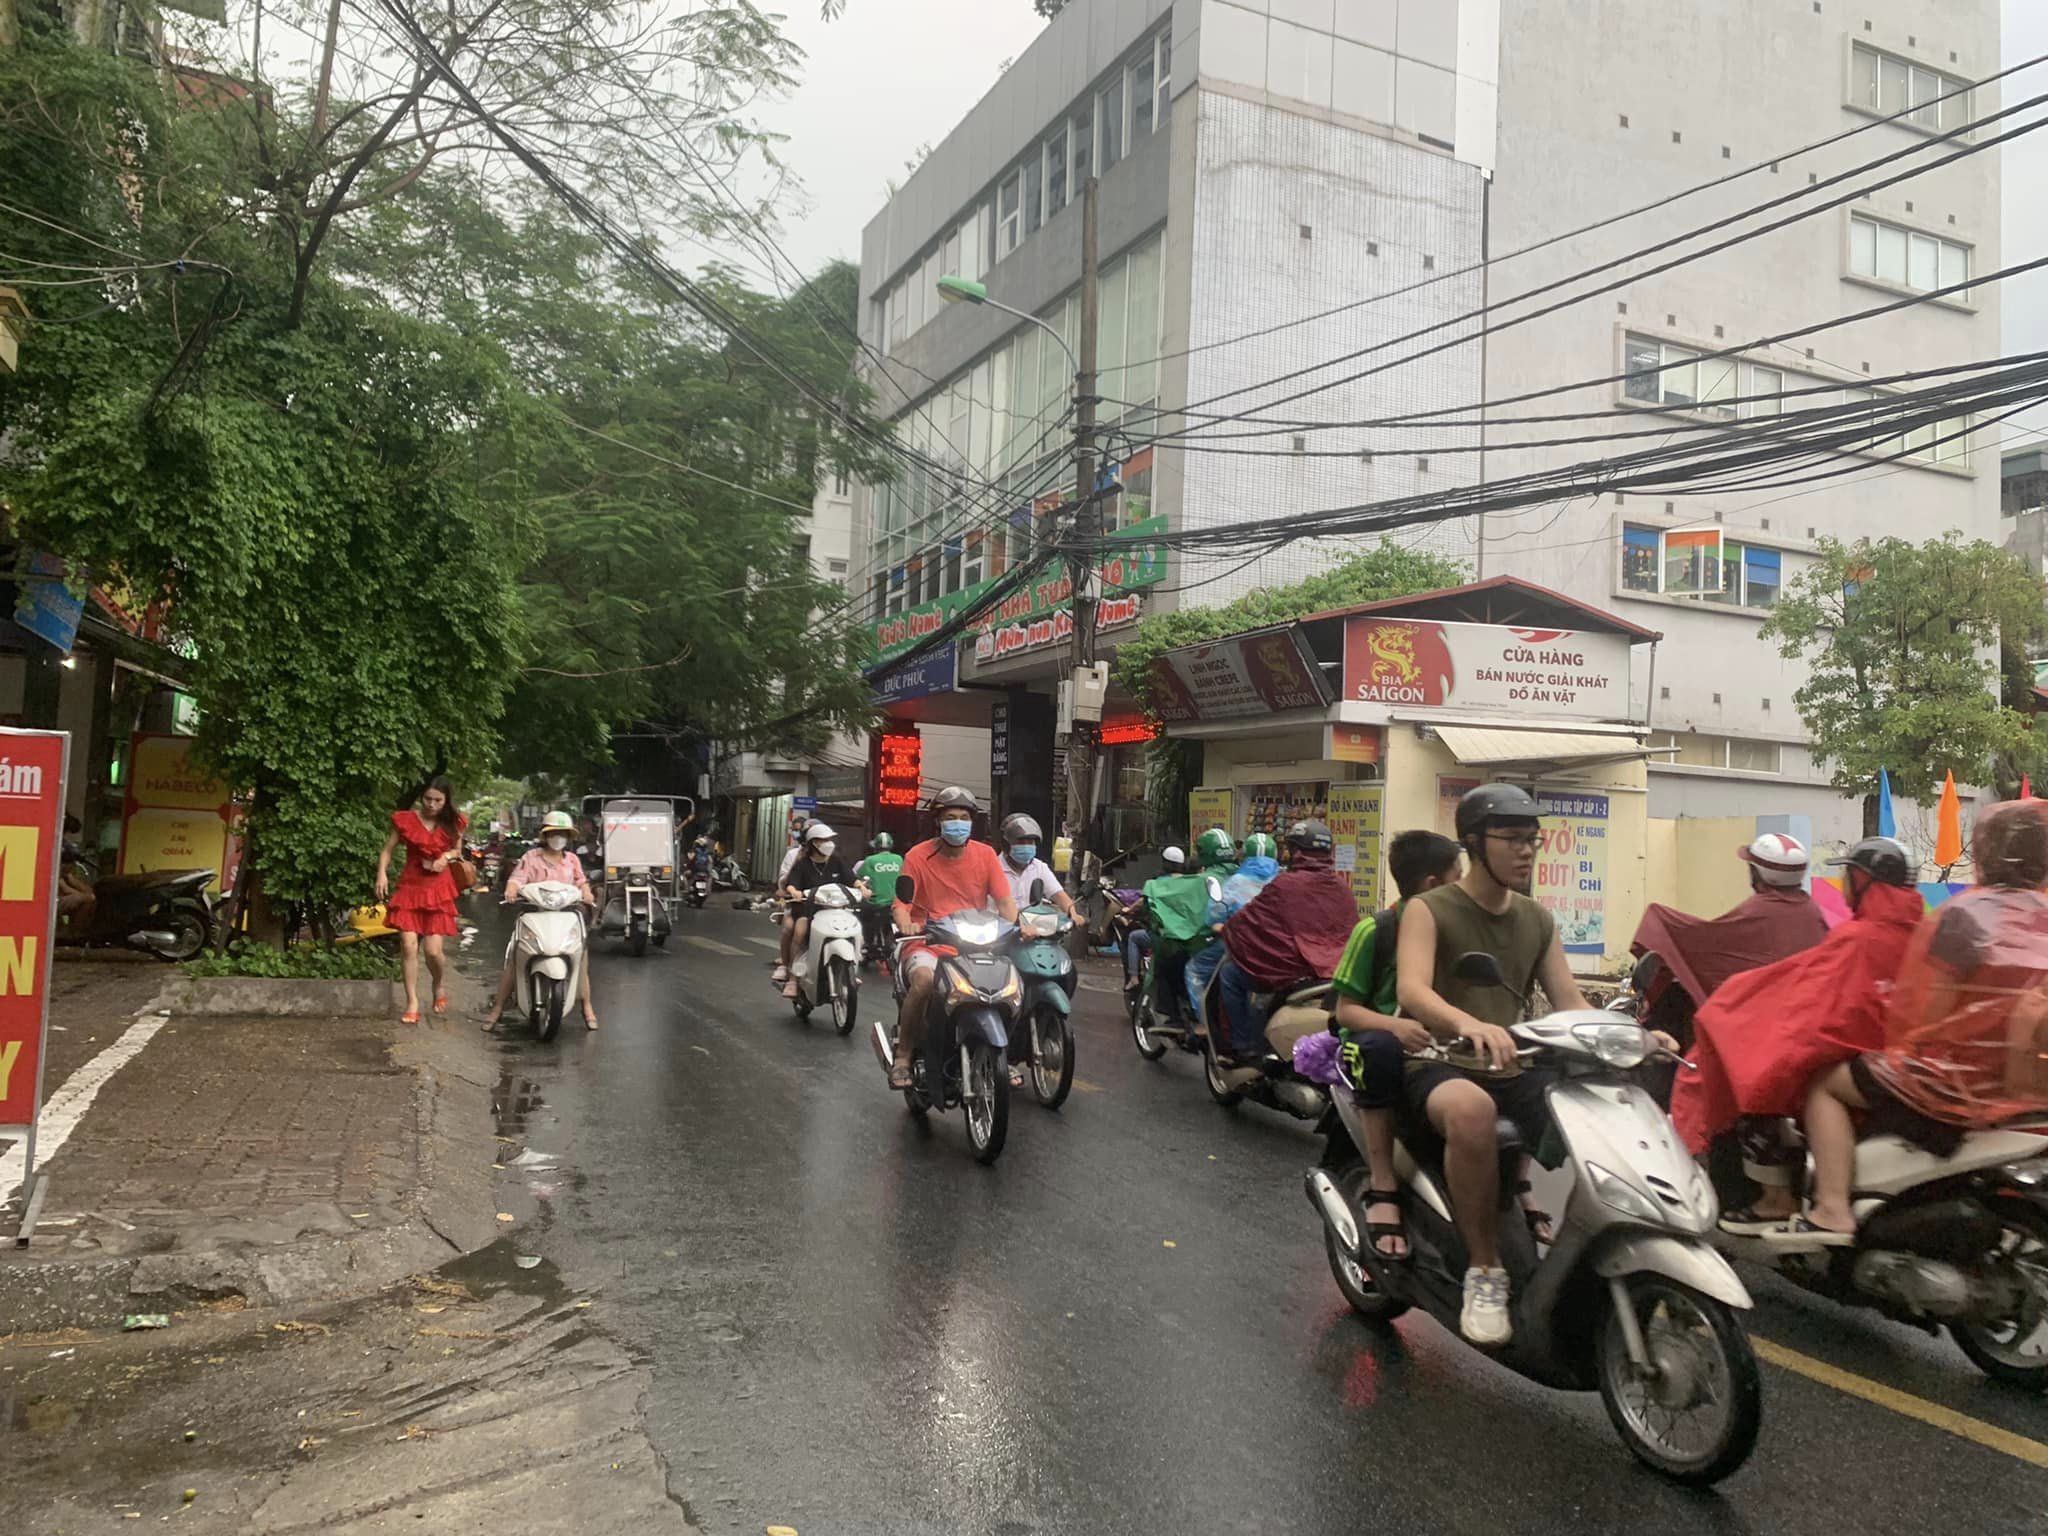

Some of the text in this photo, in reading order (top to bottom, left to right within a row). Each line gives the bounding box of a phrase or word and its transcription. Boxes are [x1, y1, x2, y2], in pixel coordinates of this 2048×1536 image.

[1503, 645, 1584, 666] CỬA HÀNG
[1382, 675, 1402, 686] BIA
[1476, 667, 1608, 689] BÁN NƯỚC GIẢI KHÁT
[1358, 684, 1425, 702] SAIGON
[1532, 687, 1550, 701] ĂN
[1552, 689, 1577, 706] VẶT
[874, 861, 899, 873] Grab
[1538, 859, 1570, 887] BÚT
[1580, 860, 1593, 873] BI
